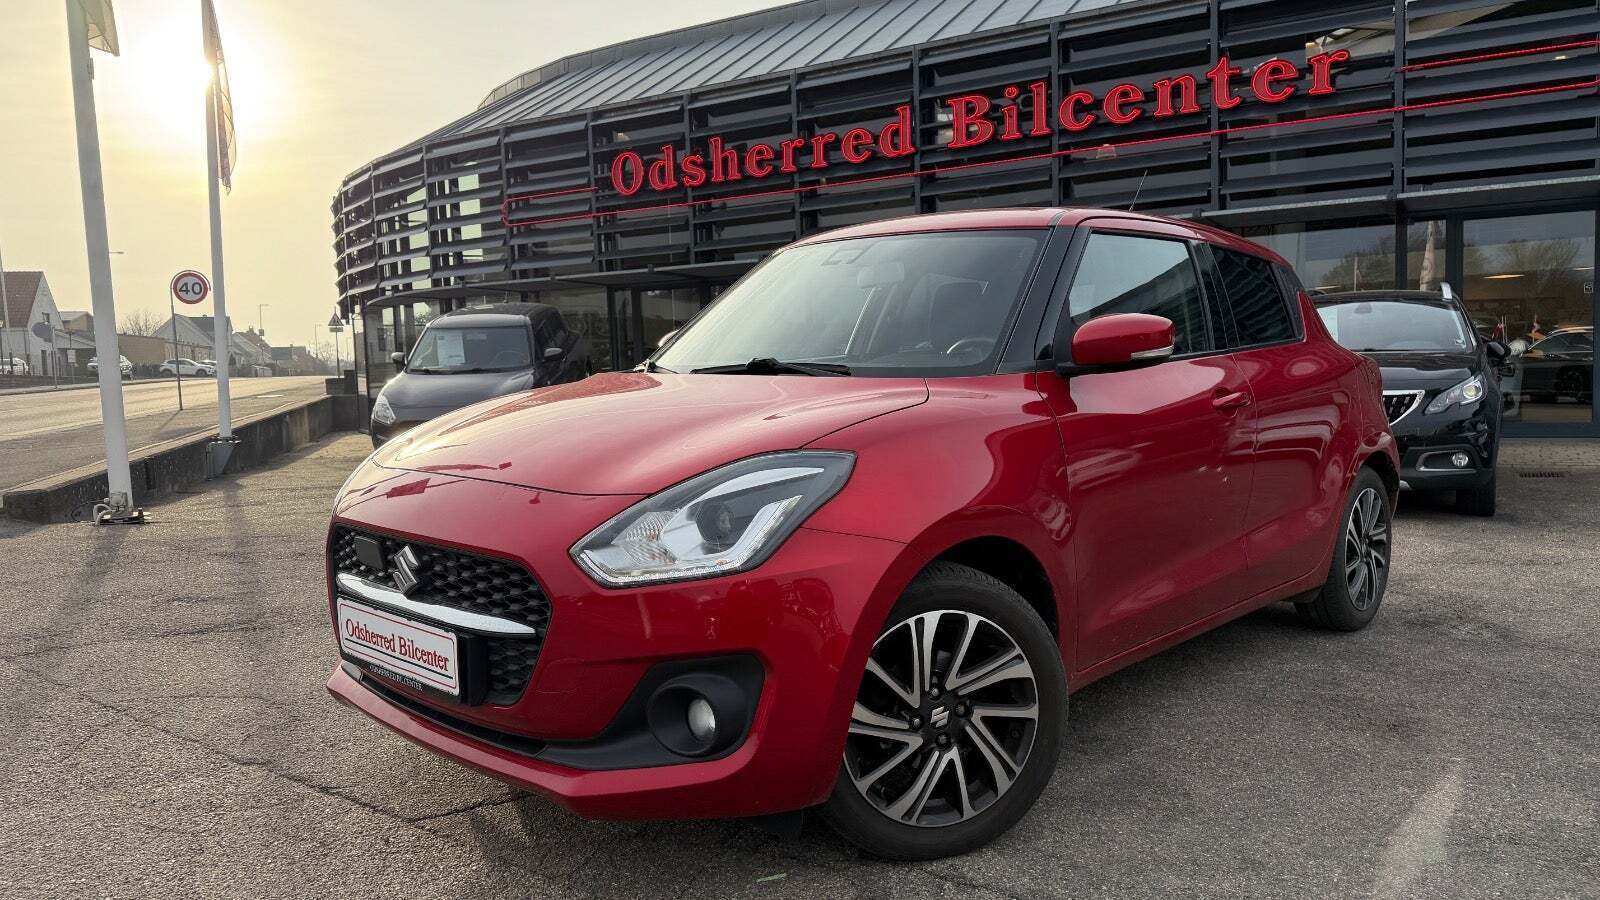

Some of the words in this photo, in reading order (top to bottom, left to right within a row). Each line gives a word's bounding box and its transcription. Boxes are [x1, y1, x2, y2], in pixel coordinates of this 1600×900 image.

[610, 105, 916, 196] Odsherred
[945, 48, 1351, 150] Bilcenter
[178, 282, 203, 296] 40
[345, 618, 396, 653] Odsherred
[398, 635, 450, 672] Bilcenter
